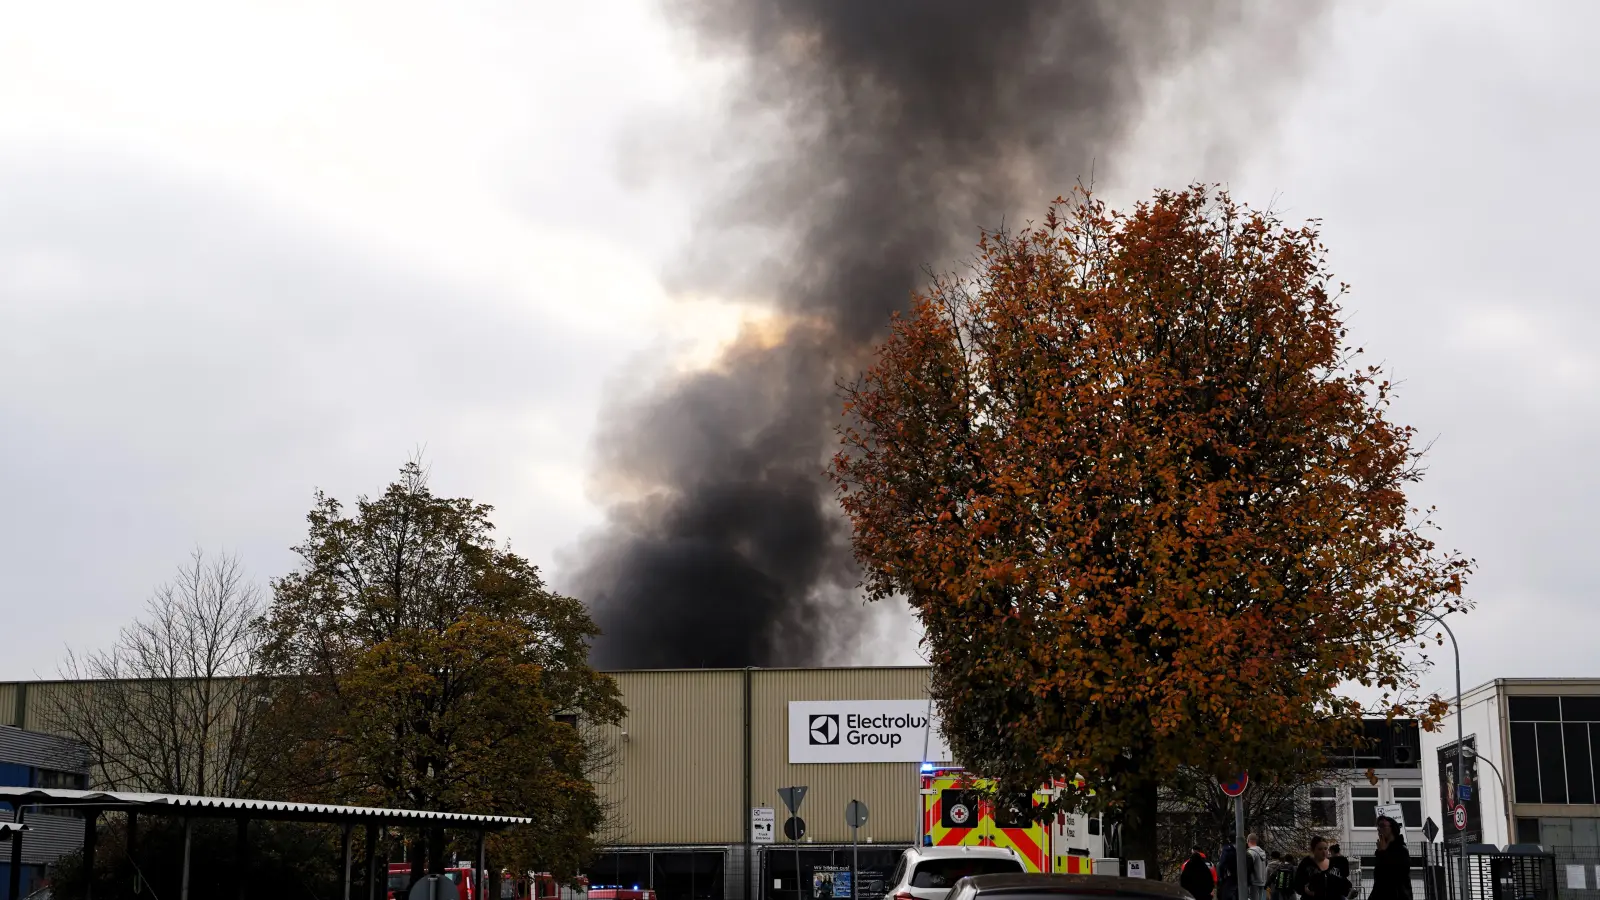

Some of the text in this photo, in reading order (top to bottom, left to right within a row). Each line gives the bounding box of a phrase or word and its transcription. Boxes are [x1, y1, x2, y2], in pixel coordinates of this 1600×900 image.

[847, 713, 931, 728] Electrolux
[847, 730, 902, 748] Group
[1456, 811, 1464, 823] 30
